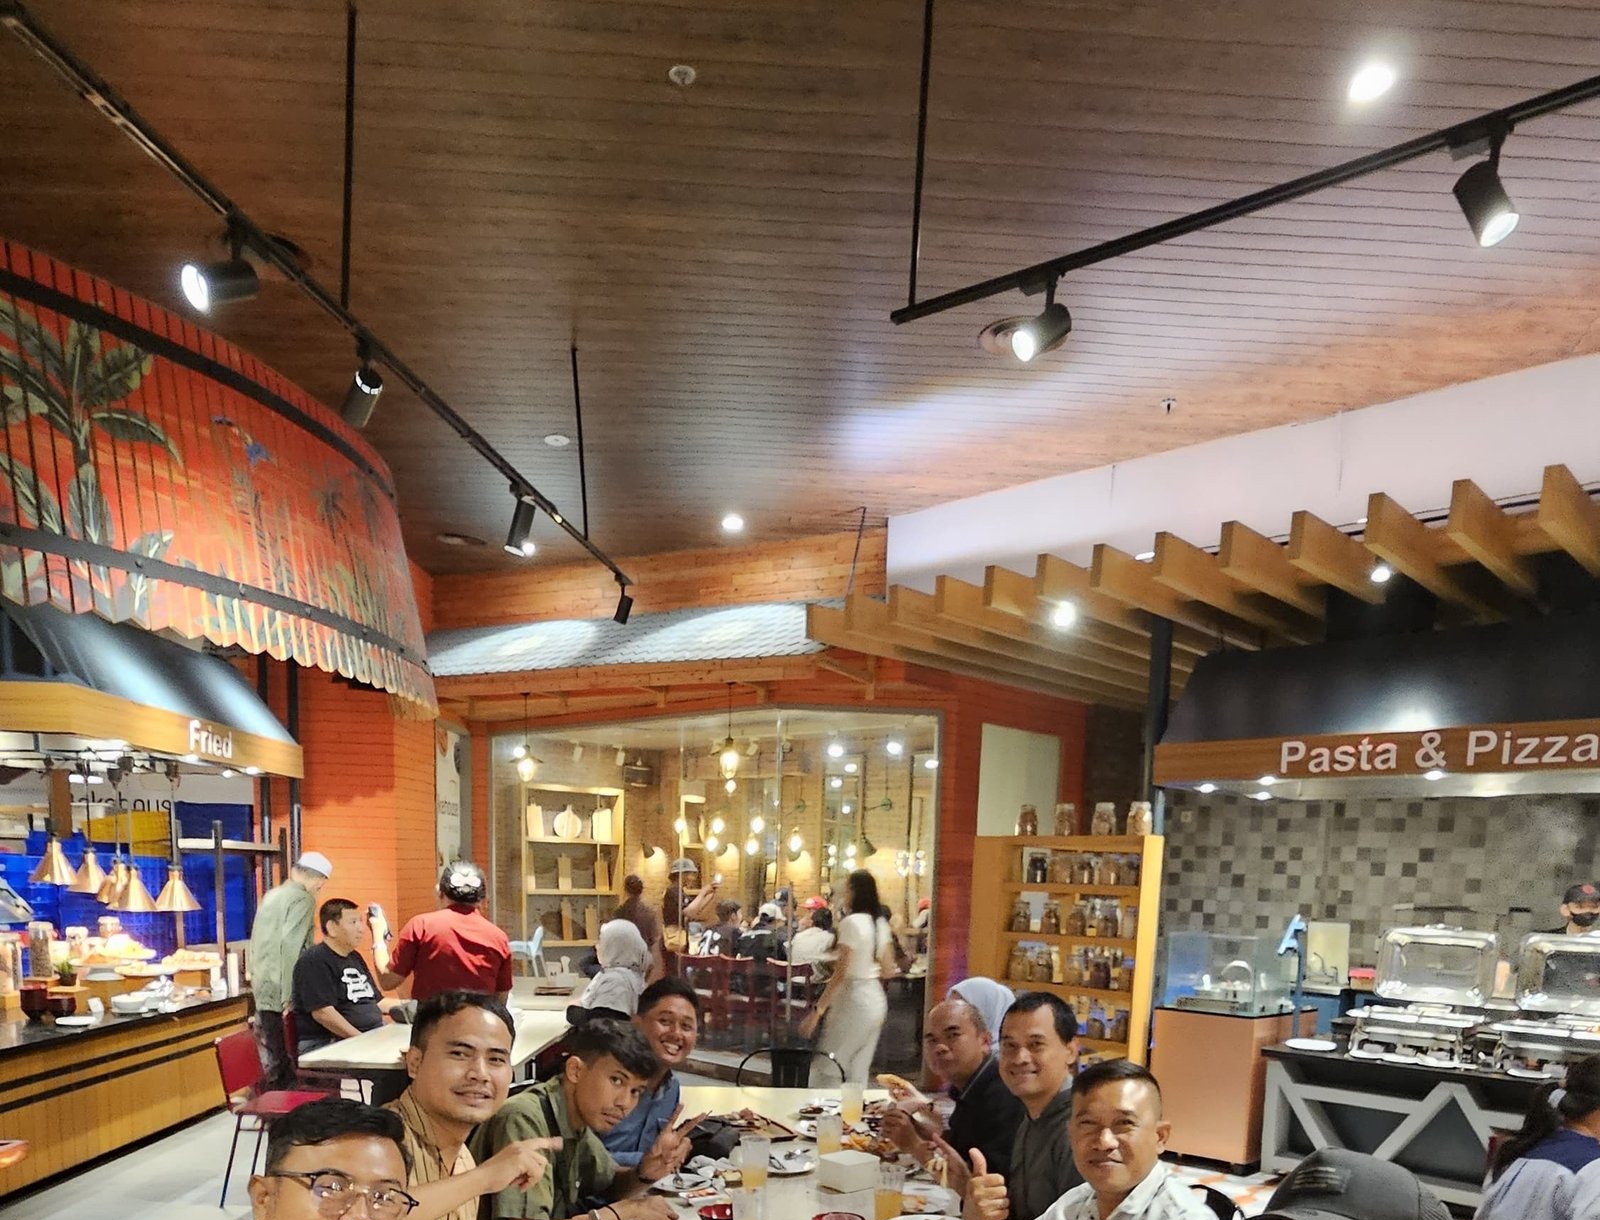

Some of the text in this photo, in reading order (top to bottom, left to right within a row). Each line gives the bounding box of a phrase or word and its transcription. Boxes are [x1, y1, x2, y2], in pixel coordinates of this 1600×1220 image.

[190, 719, 233, 759] Fried
[1280, 730, 1600, 774] Pasta & Pizza
